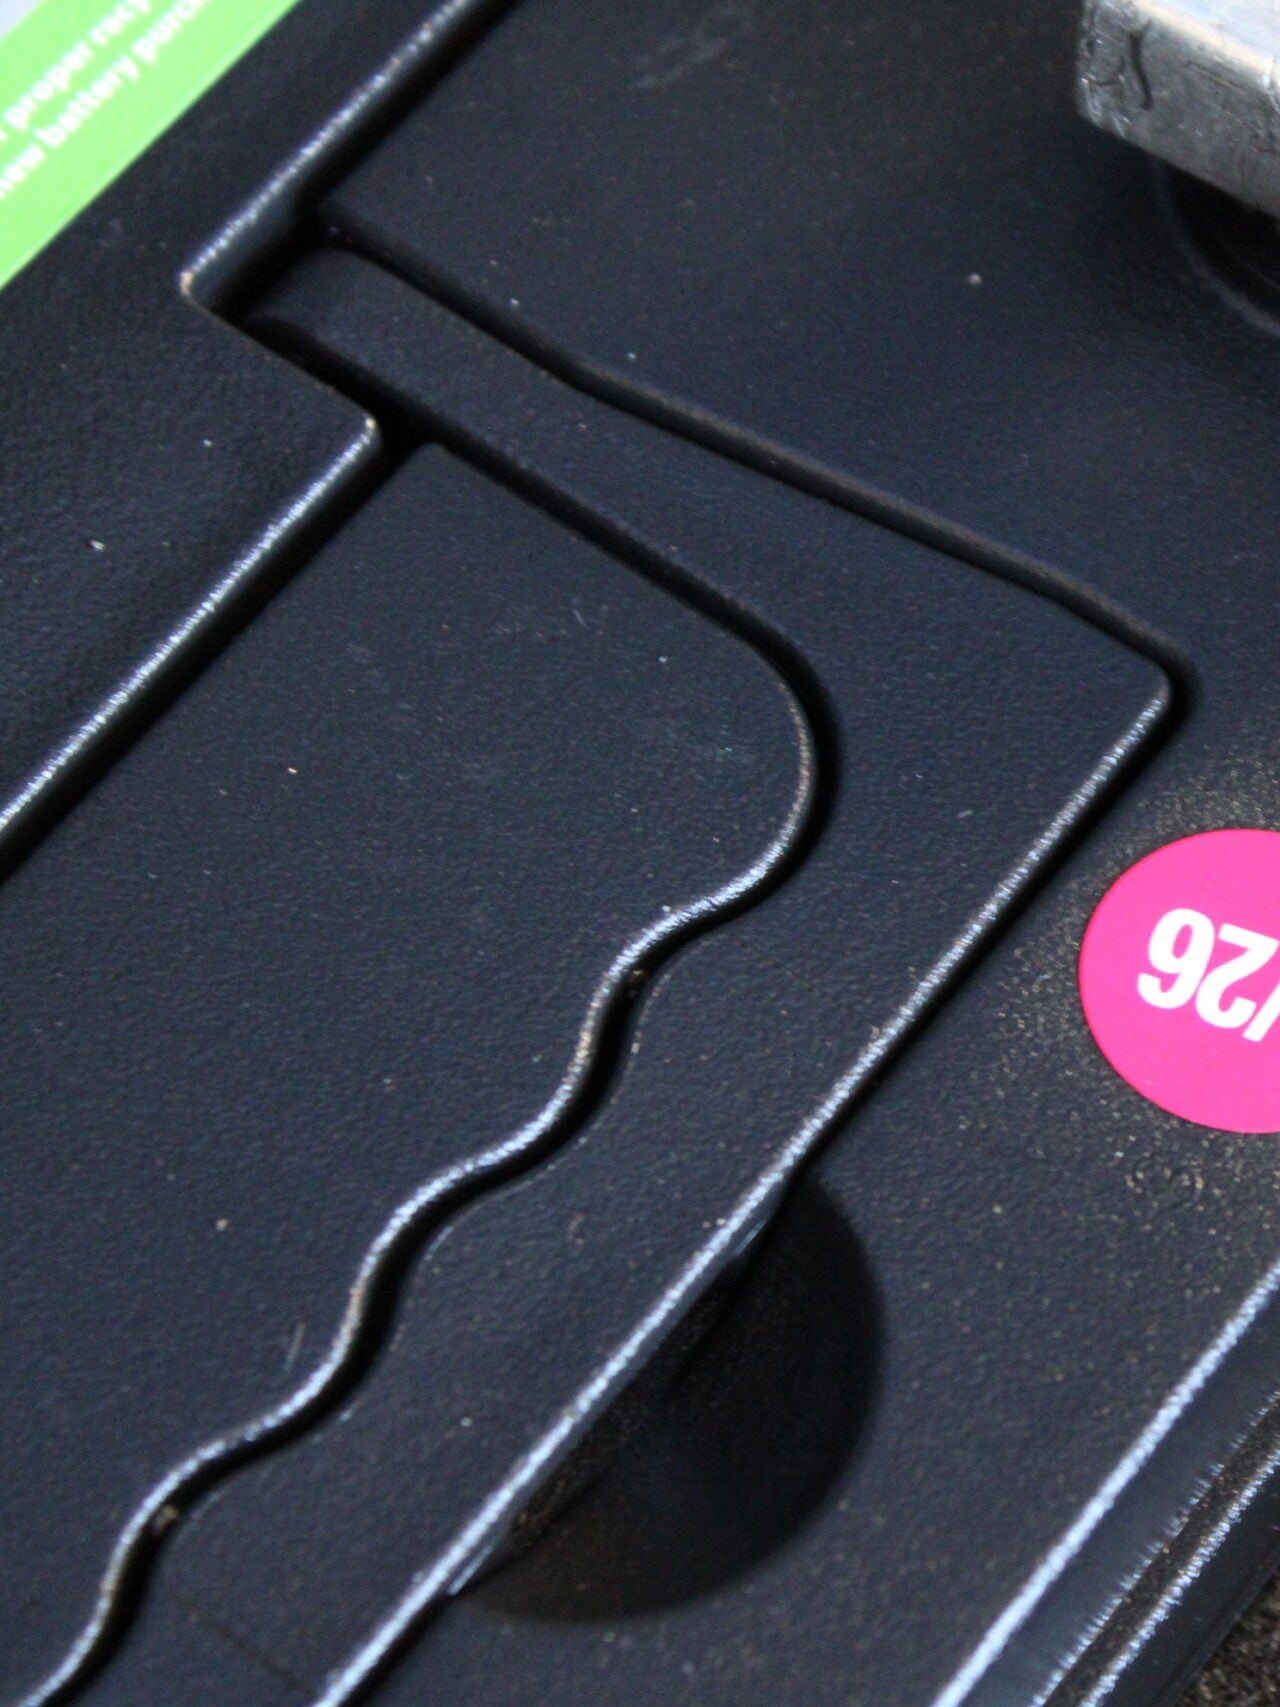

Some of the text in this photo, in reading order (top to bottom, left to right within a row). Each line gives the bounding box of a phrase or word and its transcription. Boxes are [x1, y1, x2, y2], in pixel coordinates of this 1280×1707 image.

[5, 40, 92, 130] proper
[34, 55, 139, 147] battery
[131, 0, 207, 64] purc
